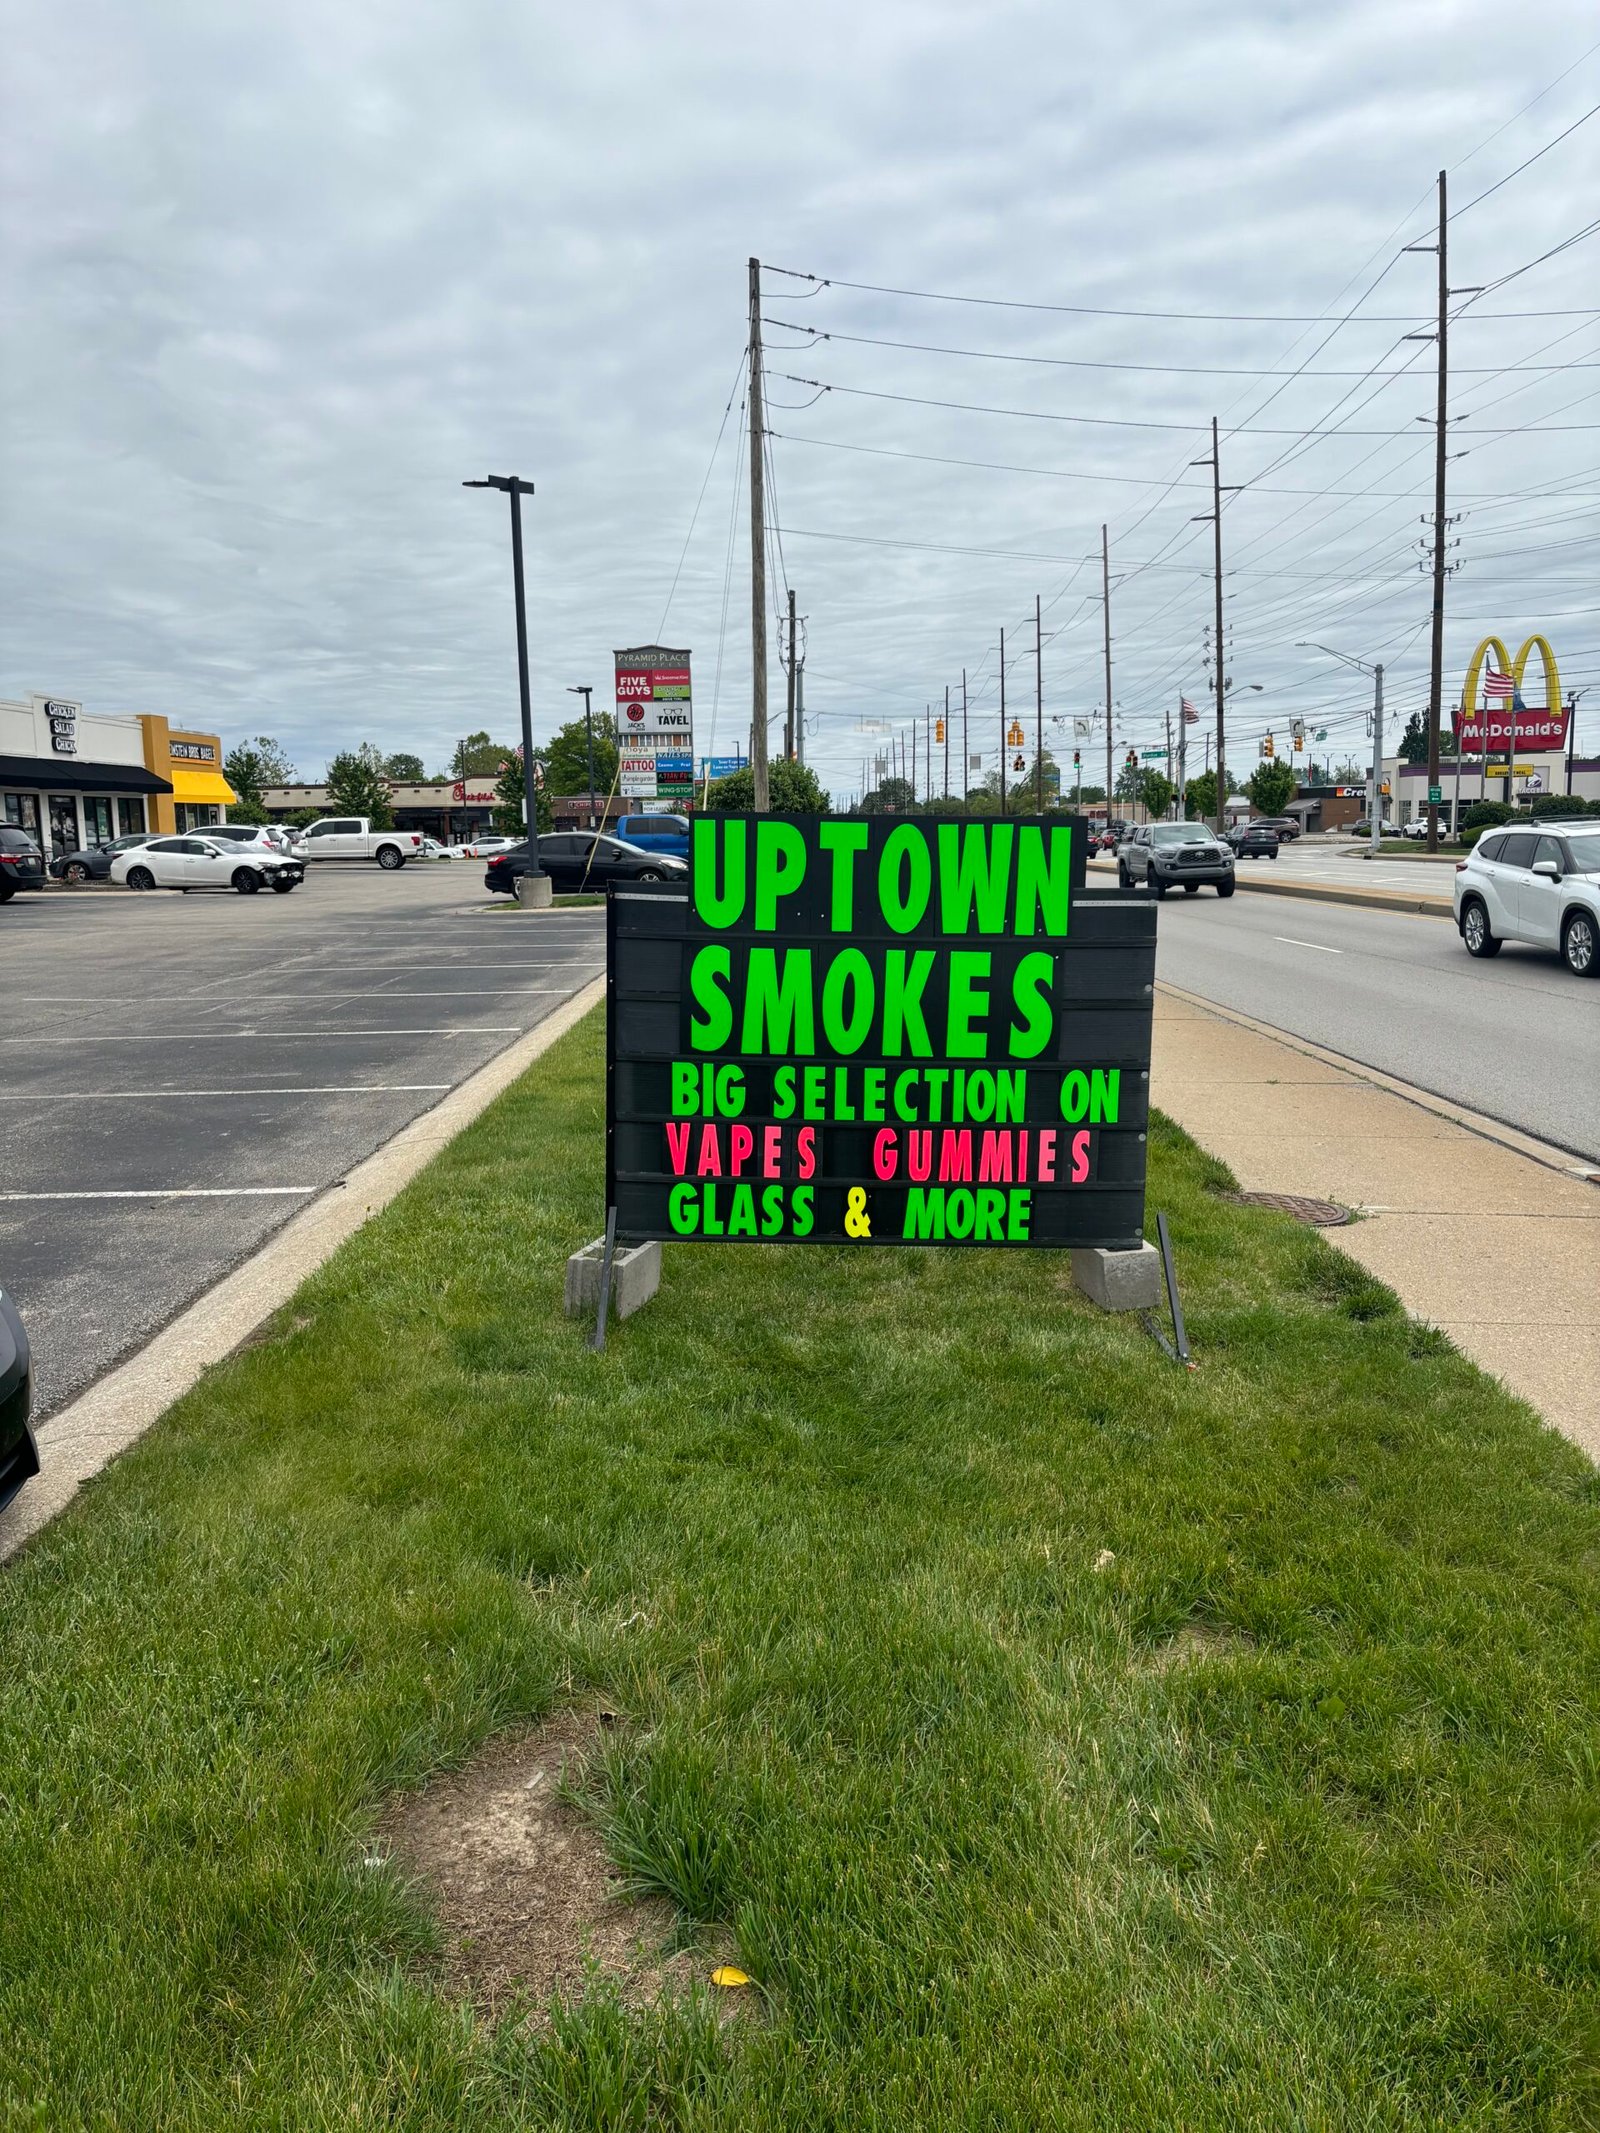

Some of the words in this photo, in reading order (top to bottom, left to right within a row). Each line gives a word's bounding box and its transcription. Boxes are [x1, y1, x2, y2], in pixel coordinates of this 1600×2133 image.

[660, 653, 687, 661] PLACE
[620, 677, 647, 686] FIVE
[617, 686, 651, 696] GUYS
[48, 701, 76, 719] CHICKEN
[53, 720, 75, 735] SALAD
[658, 715, 689, 725] TAVEL
[1462, 722, 1563, 738] McDonald's
[55, 737, 77, 753] CHICK
[621, 760, 655, 771] TATTOO
[694, 820, 1071, 936] UPTOWN
[691, 945, 1055, 1059] SMOKES
[672, 1062, 745, 1117] BIG
[774, 1066, 1026, 1123] SELECTION
[1060, 1069, 1120, 1123] ON
[666, 1123, 816, 1178] VAPES
[874, 1129, 1090, 1182] GUMMIES
[669, 1183, 814, 1236] GLASS
[845, 1187, 871, 1238] &
[903, 1188, 1031, 1240] MORE
